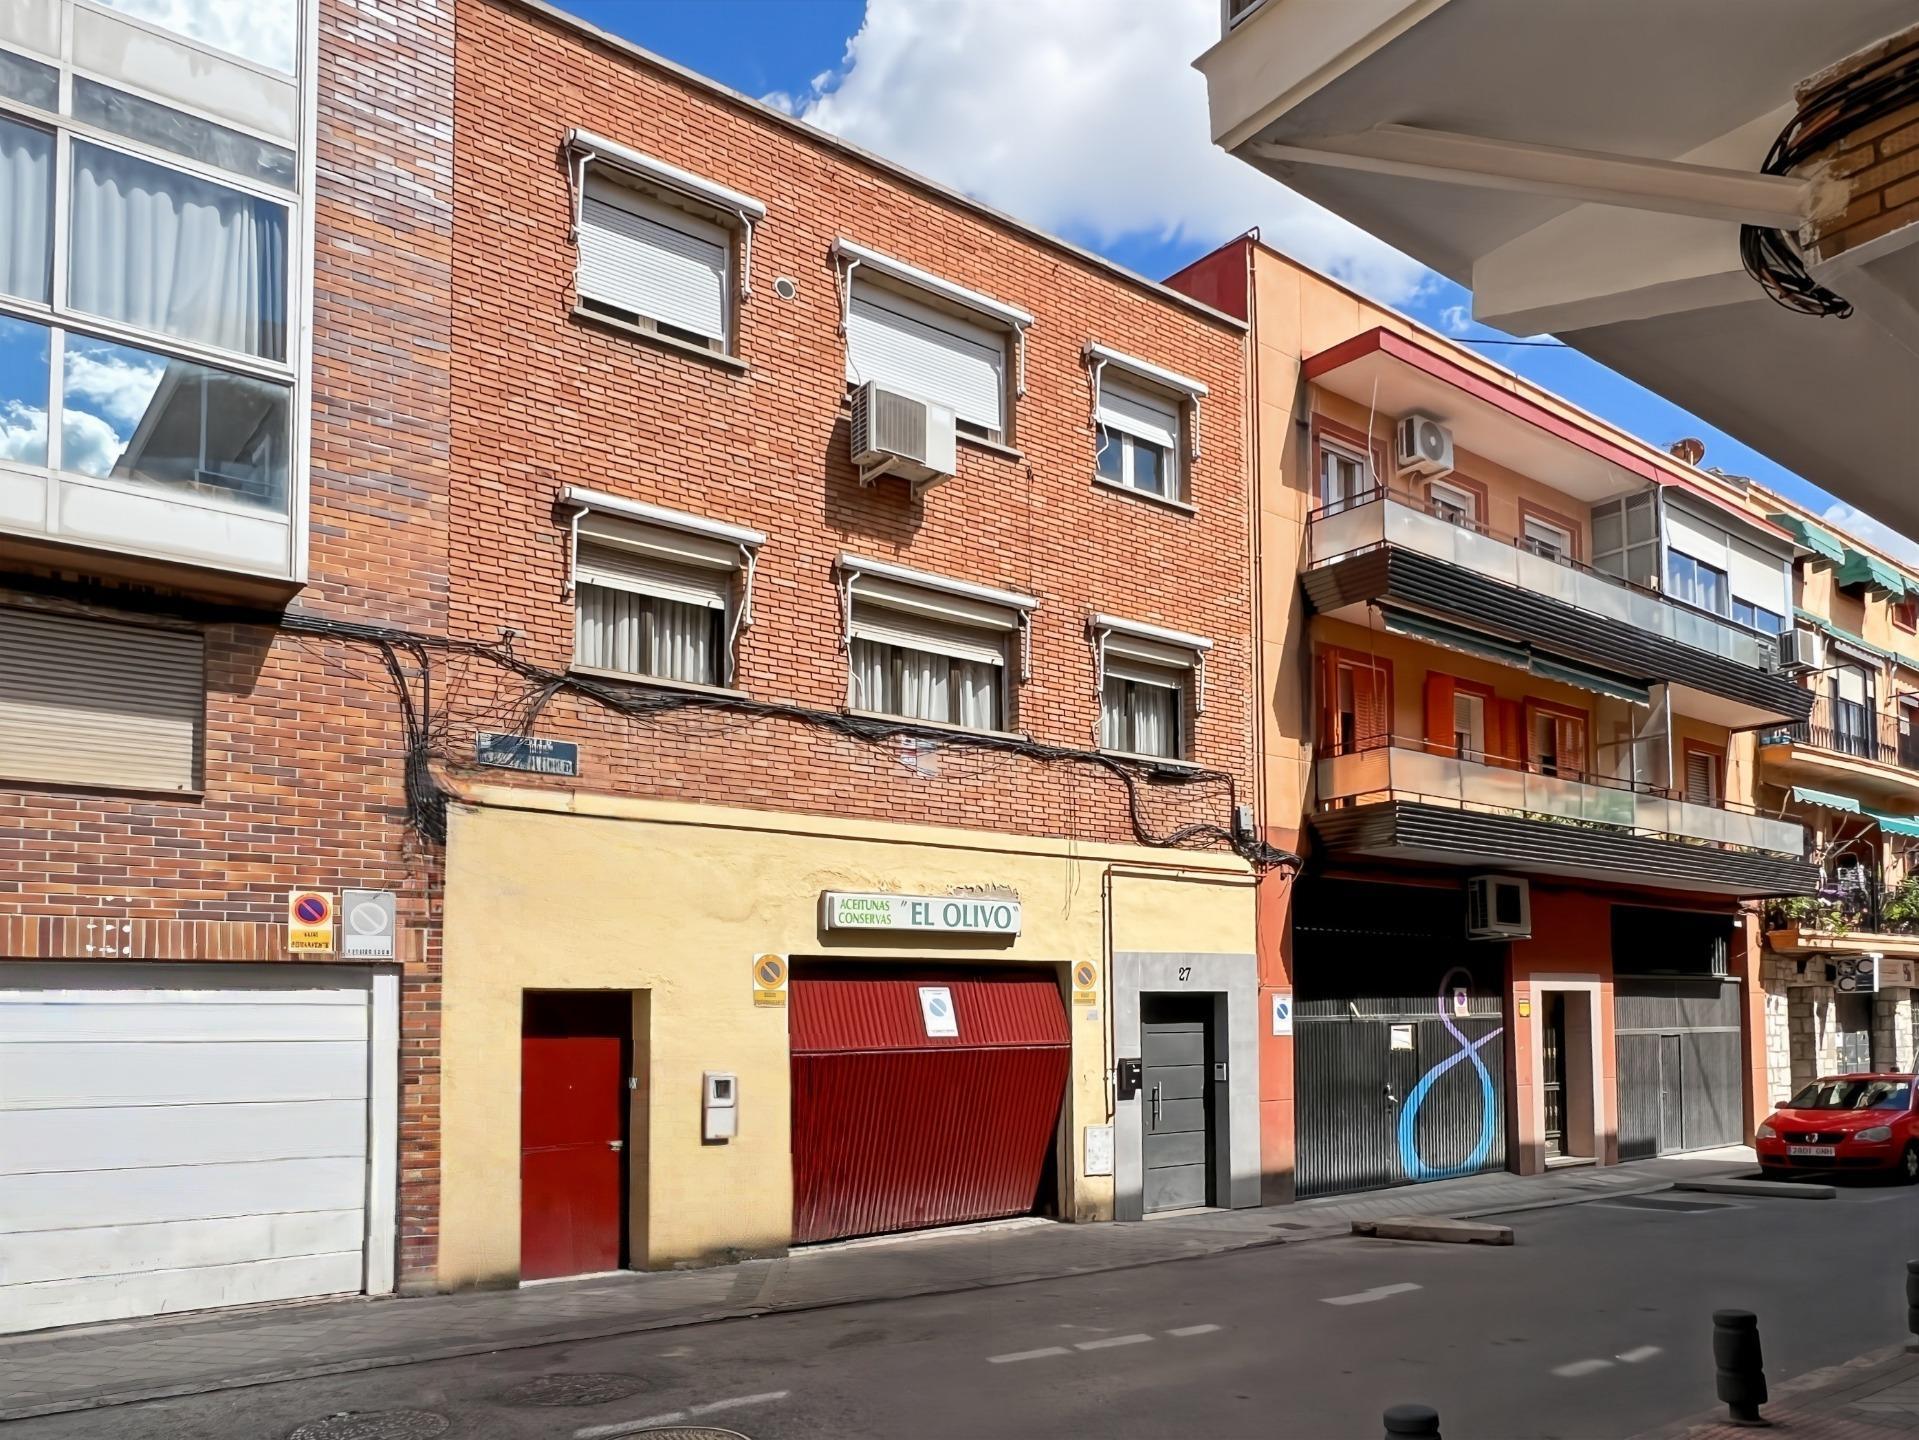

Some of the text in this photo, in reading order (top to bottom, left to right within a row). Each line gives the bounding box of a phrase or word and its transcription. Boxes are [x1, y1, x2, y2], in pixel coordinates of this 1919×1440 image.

[840, 898, 890, 911] ACEITUNAS
[838, 912, 892, 926] CONSERVAS
[1179, 967, 1191, 981] 27
